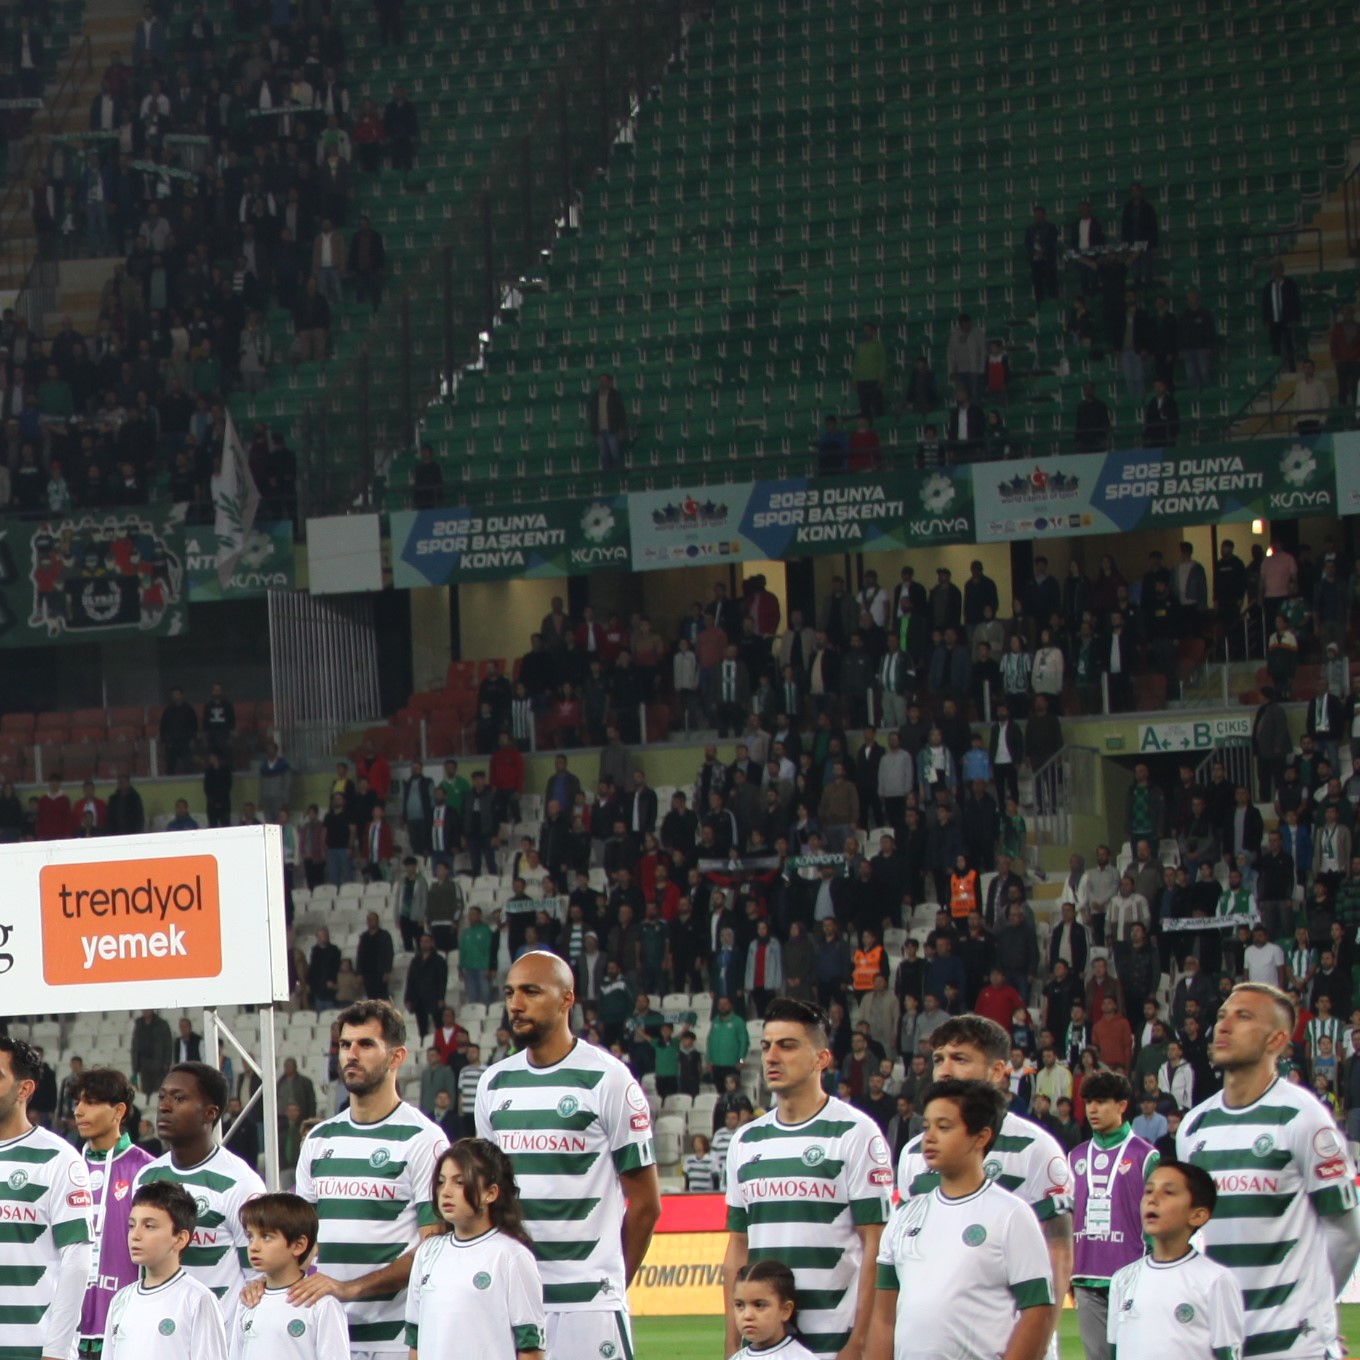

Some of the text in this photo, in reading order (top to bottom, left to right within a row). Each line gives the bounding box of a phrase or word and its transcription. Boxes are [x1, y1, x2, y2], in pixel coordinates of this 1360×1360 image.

[1122, 463, 1173, 481] 2023
[1105, 482, 1159, 500] SPOR
[770, 493, 820, 510] 2023
[1152, 496, 1219, 515] KONYA
[432, 519, 483, 536] 2023
[754, 511, 807, 528] SPOR
[798, 524, 862, 542] KONYA
[417, 539, 468, 556] SPOR
[460, 552, 524, 570] KONYA
[58, 875, 201, 921] trendyol
[81, 923, 186, 969] yemek
[502, 1132, 586, 1153] TÜMOSAN
[317, 1176, 396, 1199] TÜMOSAN
[749, 1176, 837, 1199] TÜMOSAN
